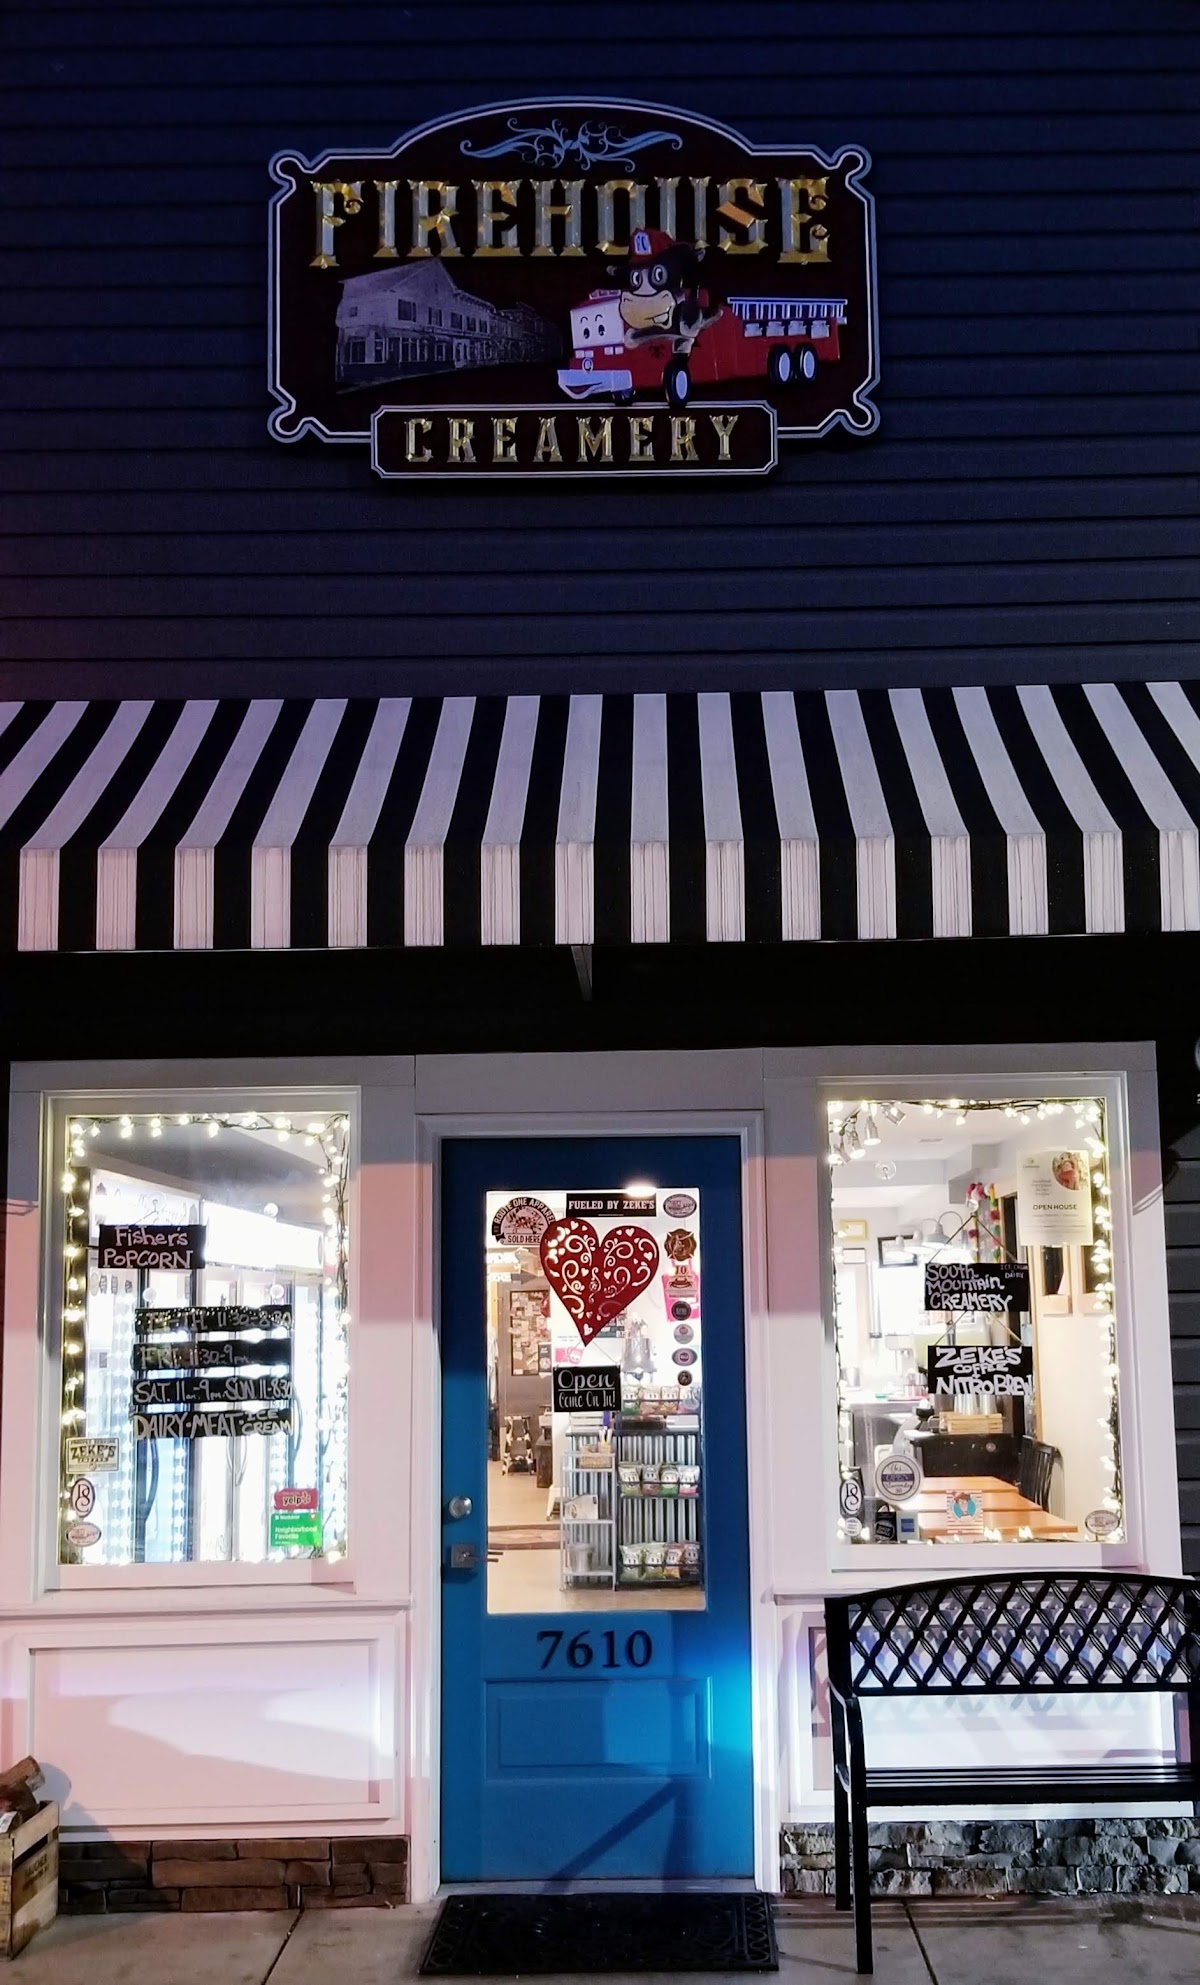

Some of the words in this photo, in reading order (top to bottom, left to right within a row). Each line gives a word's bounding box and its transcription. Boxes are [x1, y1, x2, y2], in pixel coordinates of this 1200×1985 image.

[309, 174, 832, 269] FIREHOUSE
[403, 414, 740, 463] CREAMERY
[493, 1204, 513, 1224] ROUTE
[512, 1197, 528, 1207] ONE
[568, 1200, 604, 1210] FUELED
[606, 1200, 619, 1210] BY
[622, 1200, 655, 1210] ZEKE'S
[114, 1225, 189, 1247] Fisher's
[507, 1234, 525, 1243] SOLD
[525, 1234, 541, 1243] HERE
[930, 1292, 1014, 1311] CREAMERY
[934, 1346, 1022, 1368] ZEKE'S
[558, 1370, 615, 1394] Open
[559, 1391, 584, 1408] Come
[586, 1391, 600, 1407] On
[70, 1444, 117, 1460] ZEKE'S
[283, 1494, 302, 1506] yelp
[537, 1629, 653, 1669] 7610
